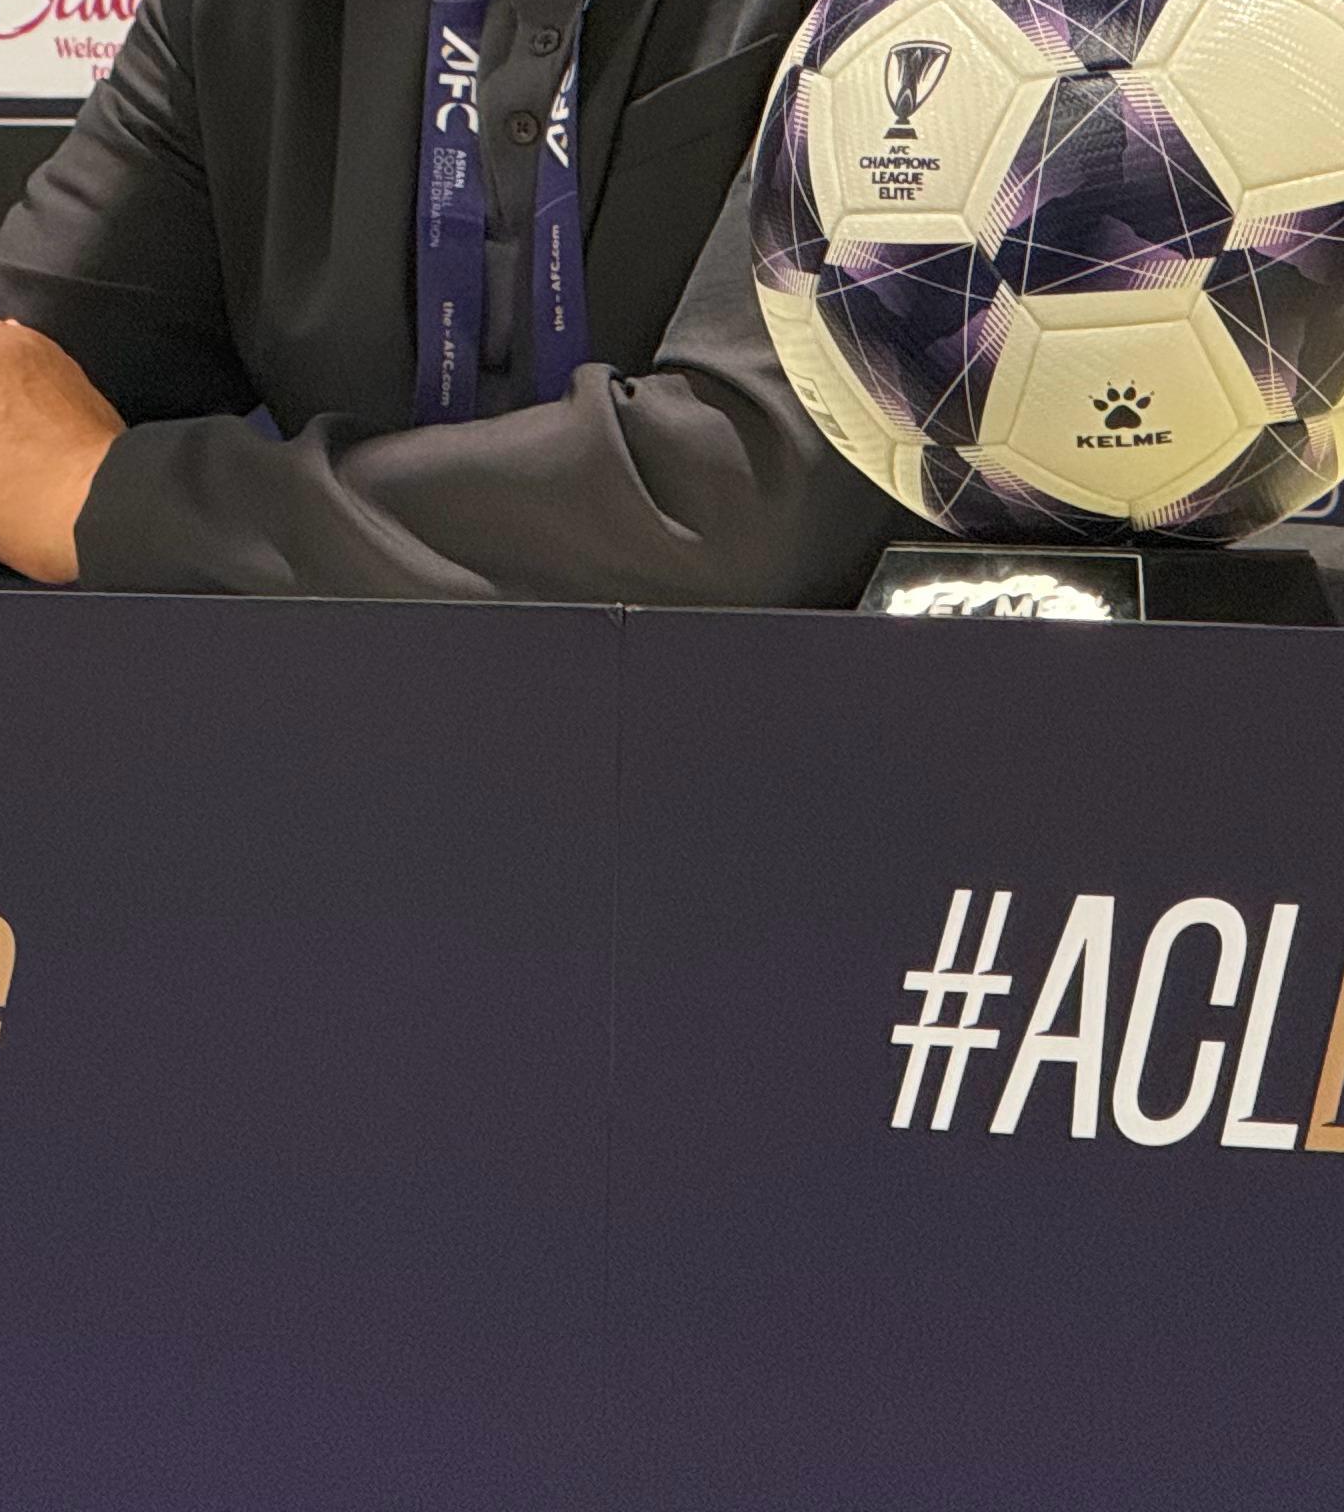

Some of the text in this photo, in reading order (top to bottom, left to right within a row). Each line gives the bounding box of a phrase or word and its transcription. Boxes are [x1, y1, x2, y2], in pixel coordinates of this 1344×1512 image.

[54, 37, 120, 58] Welco
[436, 26, 479, 133] AFC
[889, 145, 911, 156] AFC
[859, 156, 941, 171] CHAMPIONS
[871, 171, 924, 186] LEAGUE
[878, 186, 917, 201] ELITE
[1076, 430, 1173, 449] KELME
